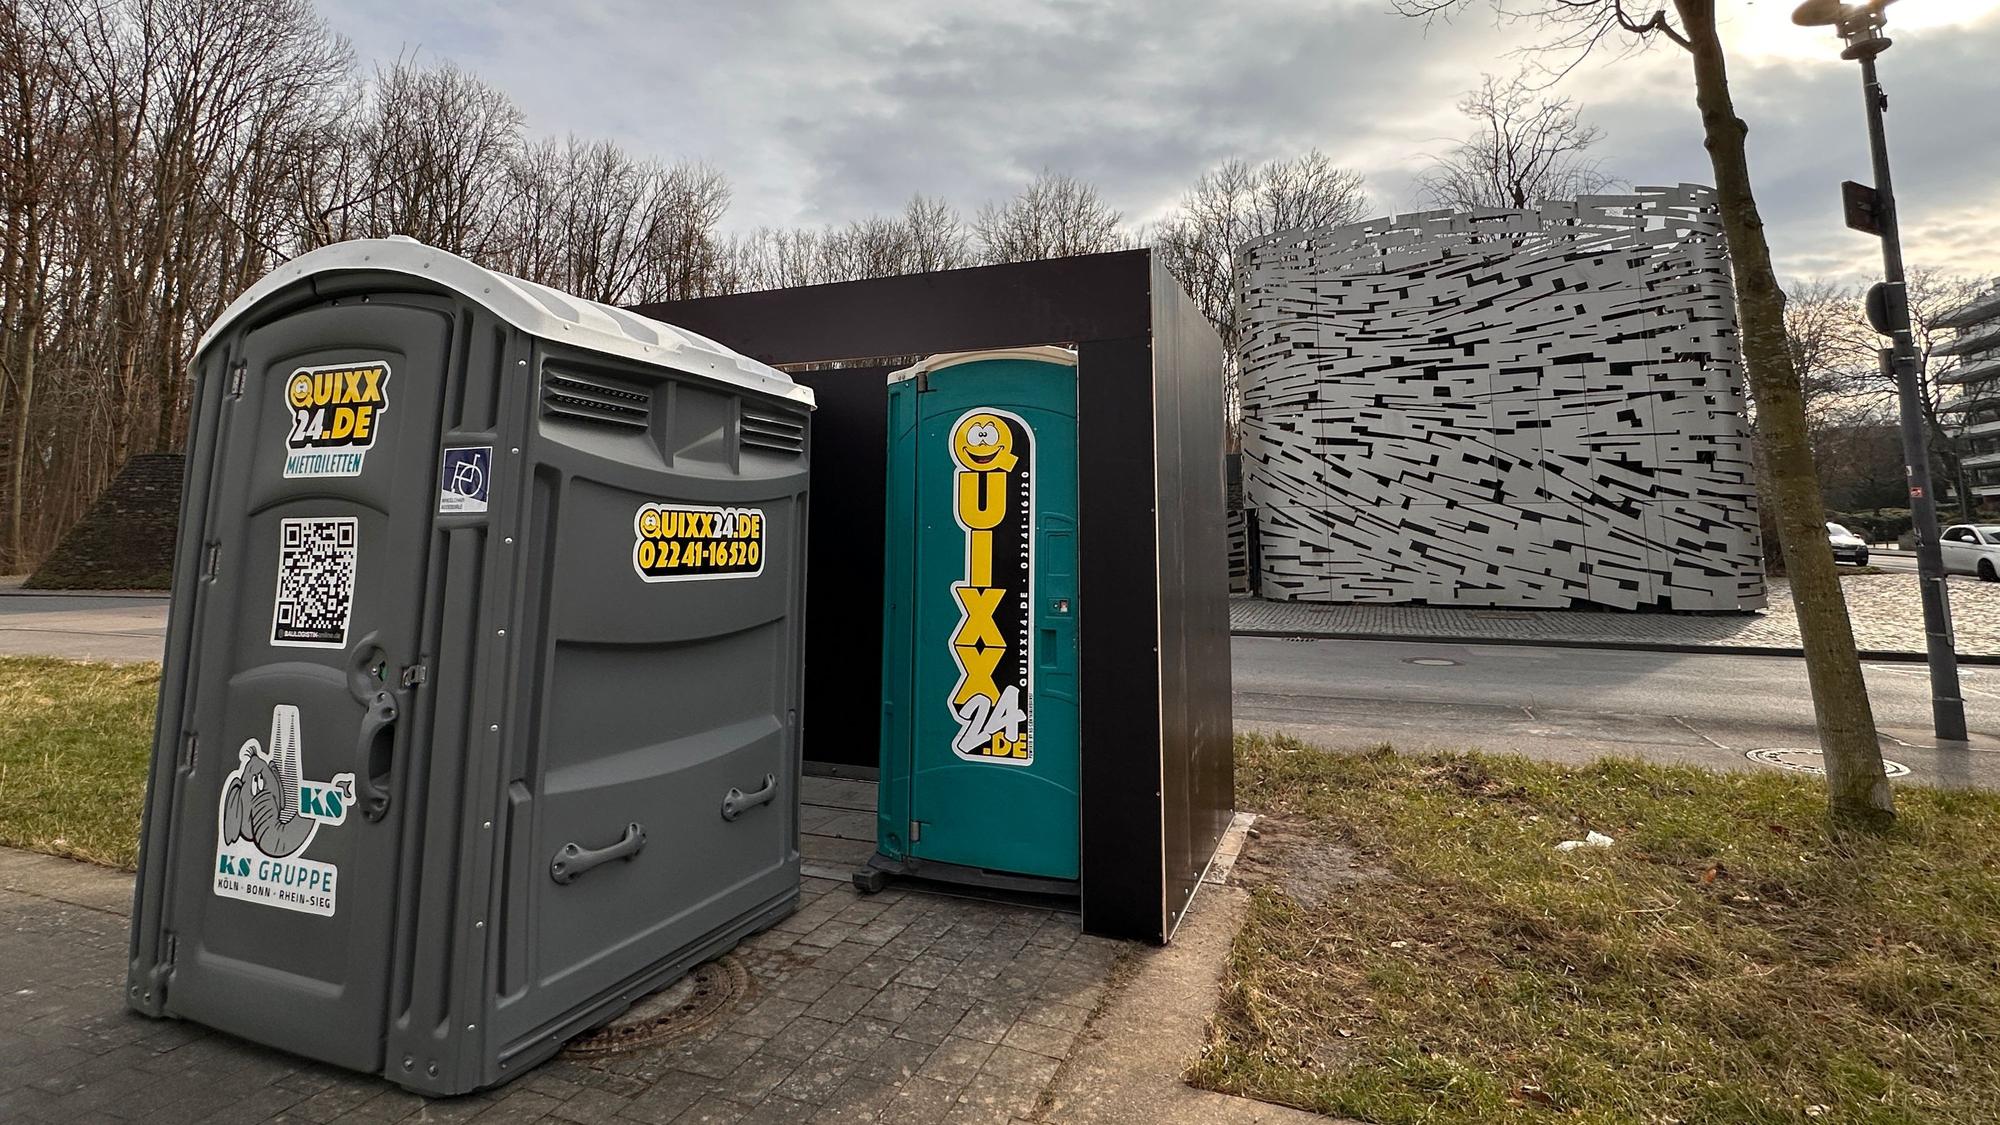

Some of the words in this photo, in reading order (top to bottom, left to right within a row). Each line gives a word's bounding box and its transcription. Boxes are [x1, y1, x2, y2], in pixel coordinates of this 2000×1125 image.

[290, 368, 383, 408] QUIXX
[291, 405, 373, 442] 24.DE
[286, 453, 362, 475] MIETTOILETTEN
[641, 510, 760, 539] QUIXX24.DE
[639, 541, 759, 569] 02241-16520
[301, 786, 343, 818] KS
[219, 854, 252, 877] KS
[259, 860, 332, 892] GRUPPE
[217, 877, 239, 891] KÖLN
[246, 884, 271, 897] BONN
[279, 890, 331, 908] RHEIN-SIEG
